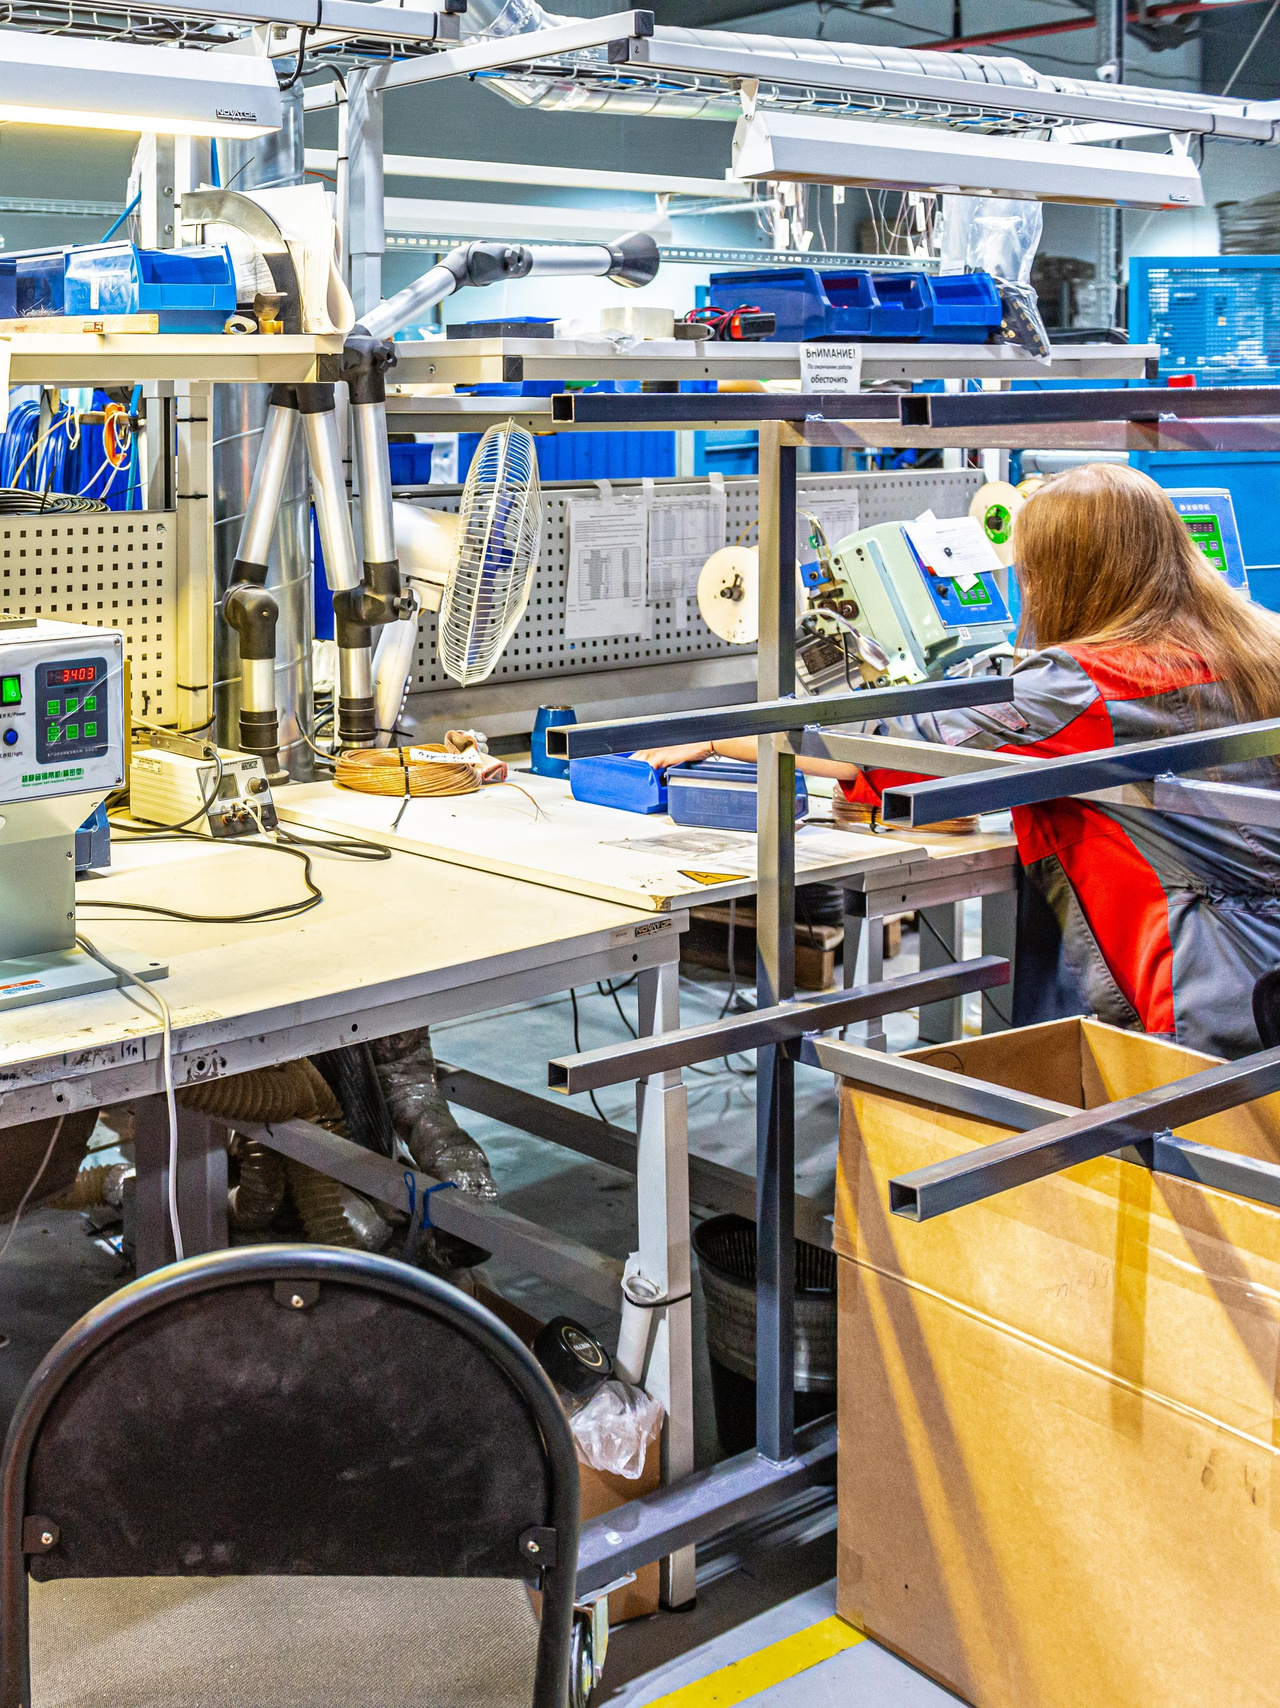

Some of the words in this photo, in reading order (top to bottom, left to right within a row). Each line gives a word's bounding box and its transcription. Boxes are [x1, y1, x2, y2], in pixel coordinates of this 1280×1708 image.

[806, 348, 856, 359] ВНИМАНИЕ!
[810, 374, 849, 384] обесточить
[63, 667, 95, 683] 3403
